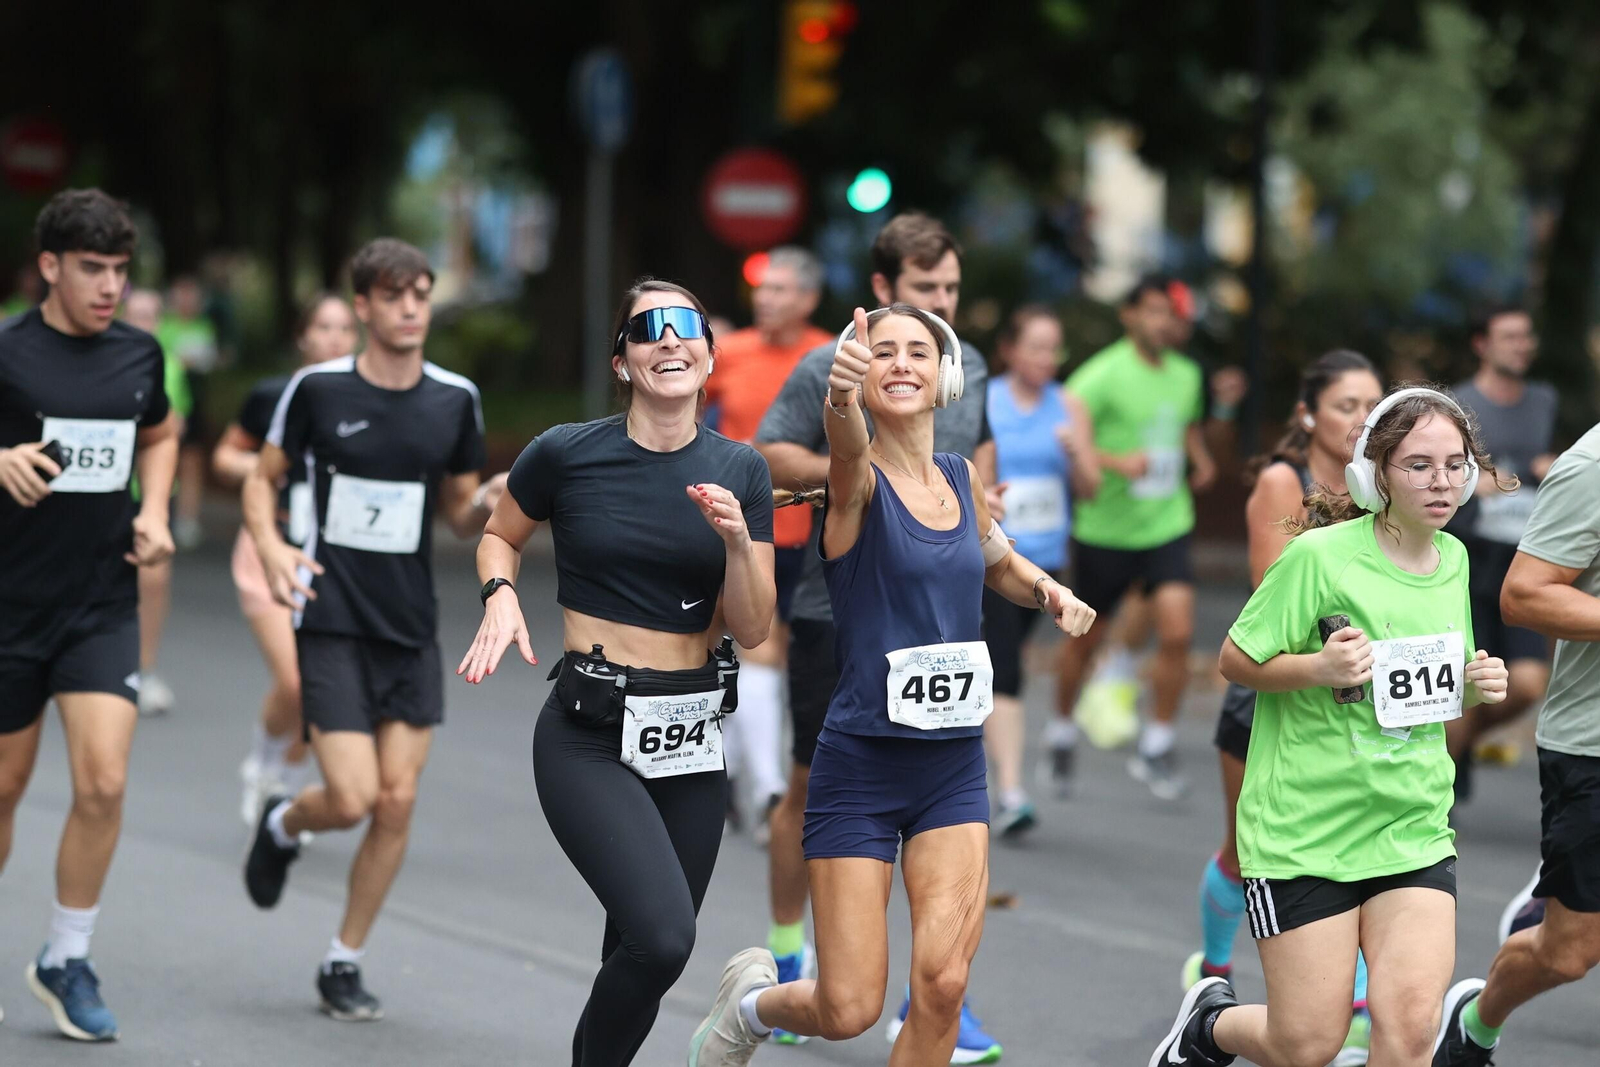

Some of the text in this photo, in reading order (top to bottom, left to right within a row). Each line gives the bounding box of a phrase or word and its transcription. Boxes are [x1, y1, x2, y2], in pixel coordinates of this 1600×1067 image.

[365, 505, 381, 527] 7
[901, 672, 974, 704] 467
[1389, 663, 1455, 700] 814
[658, 701, 701, 715] Carrera
[639, 719, 706, 754] 694
